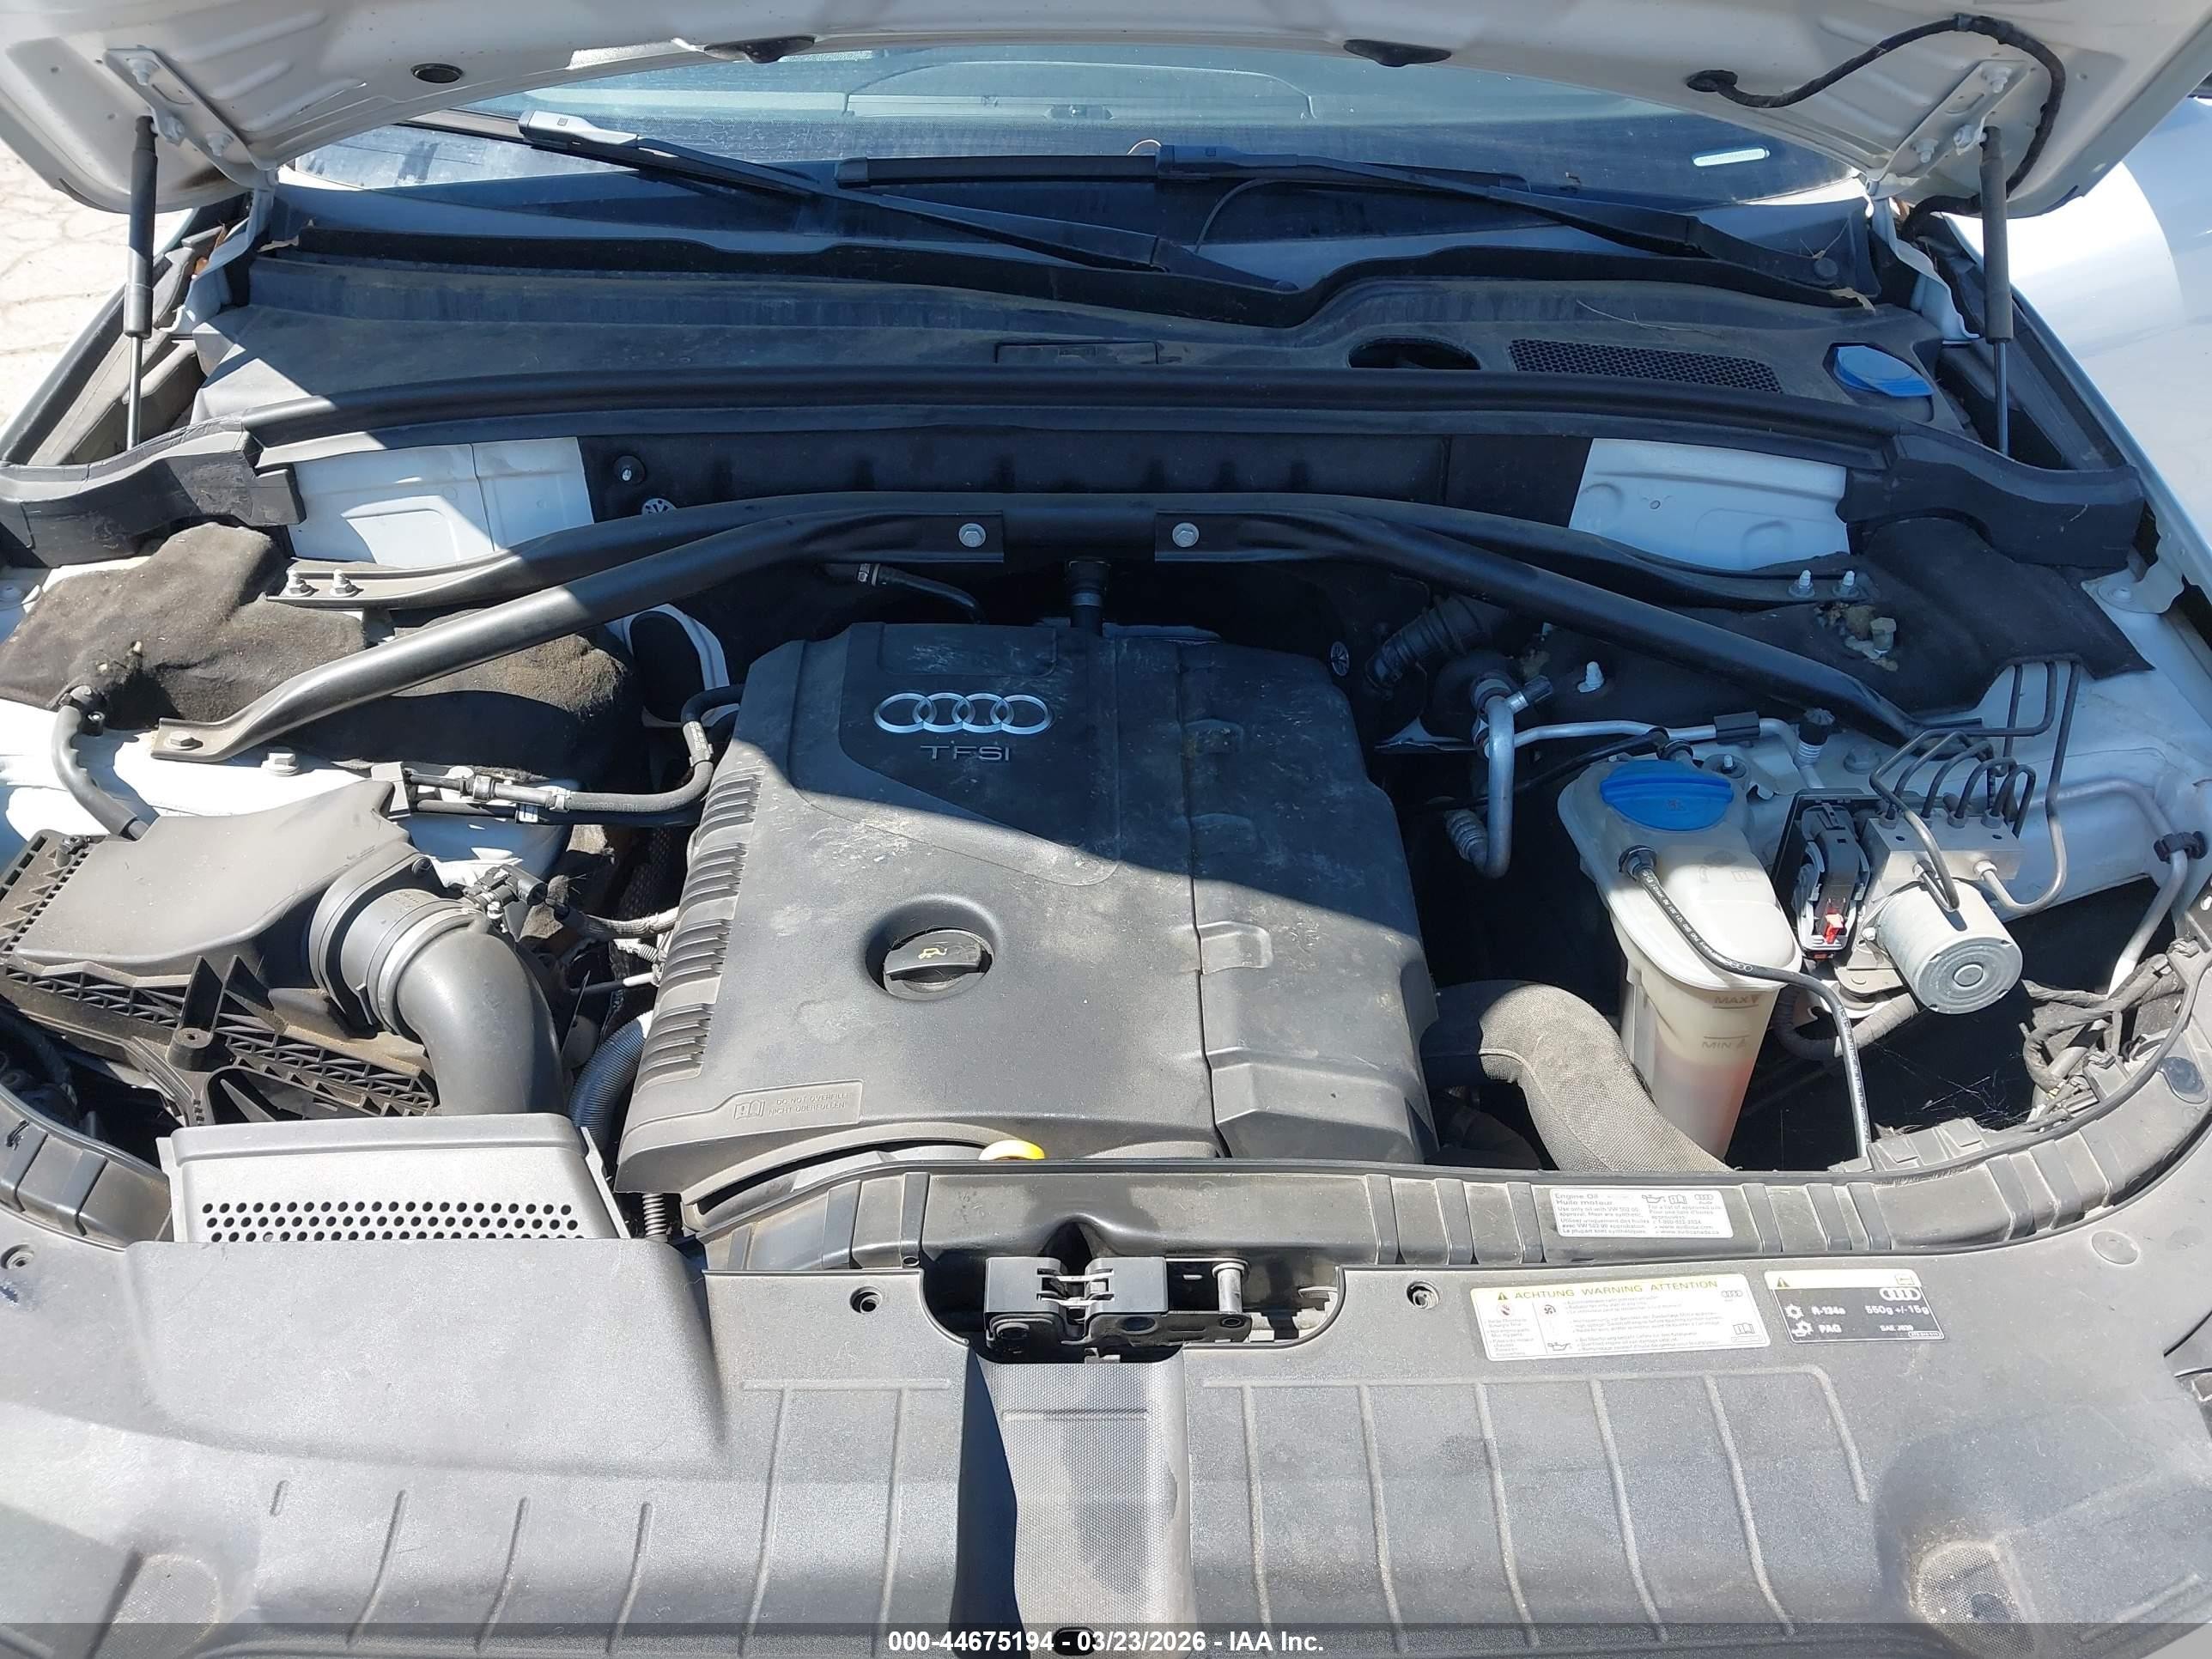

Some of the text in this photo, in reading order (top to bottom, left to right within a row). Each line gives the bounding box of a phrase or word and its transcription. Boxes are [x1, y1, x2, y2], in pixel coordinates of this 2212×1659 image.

[920, 745, 1010, 761] TFSI
[769, 1107, 792, 1115] NICHT
[1515, 1280, 1718, 1299] ACHTUNG WARNING ATTENTION
[1818, 1323, 1842, 1334] PAG
